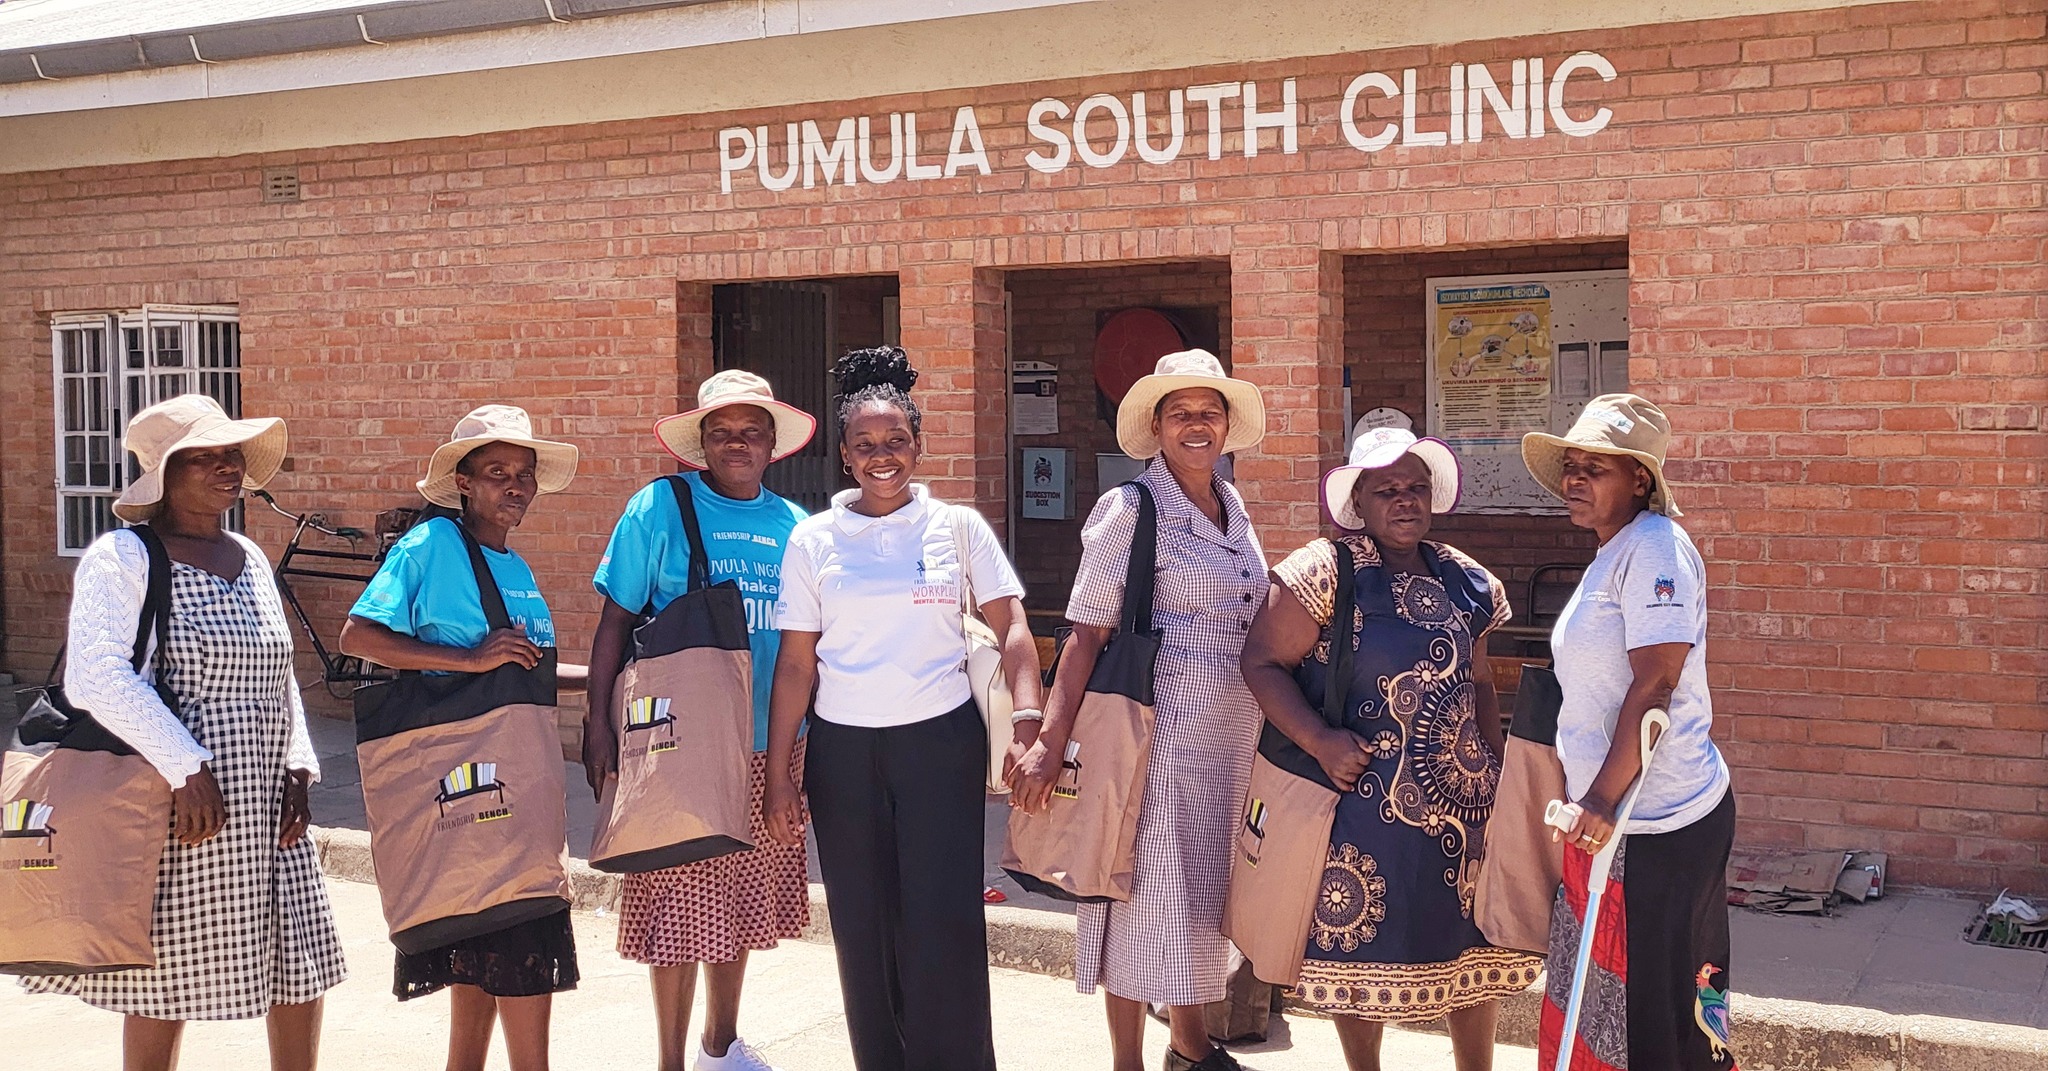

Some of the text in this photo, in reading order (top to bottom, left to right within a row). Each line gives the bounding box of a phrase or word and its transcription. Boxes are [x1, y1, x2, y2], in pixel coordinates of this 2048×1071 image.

[719, 50, 1618, 194] PUMULA SOUTH CLINIC
[1036, 499, 1049, 507] BOX
[712, 531, 750, 541] FRIENDSHIP
[651, 741, 675, 752] BENCH
[1054, 785, 1077, 797] BENCH
[437, 808, 508, 832] FRIENDSHIP BENCH
[24, 858, 55, 868] BENCH
